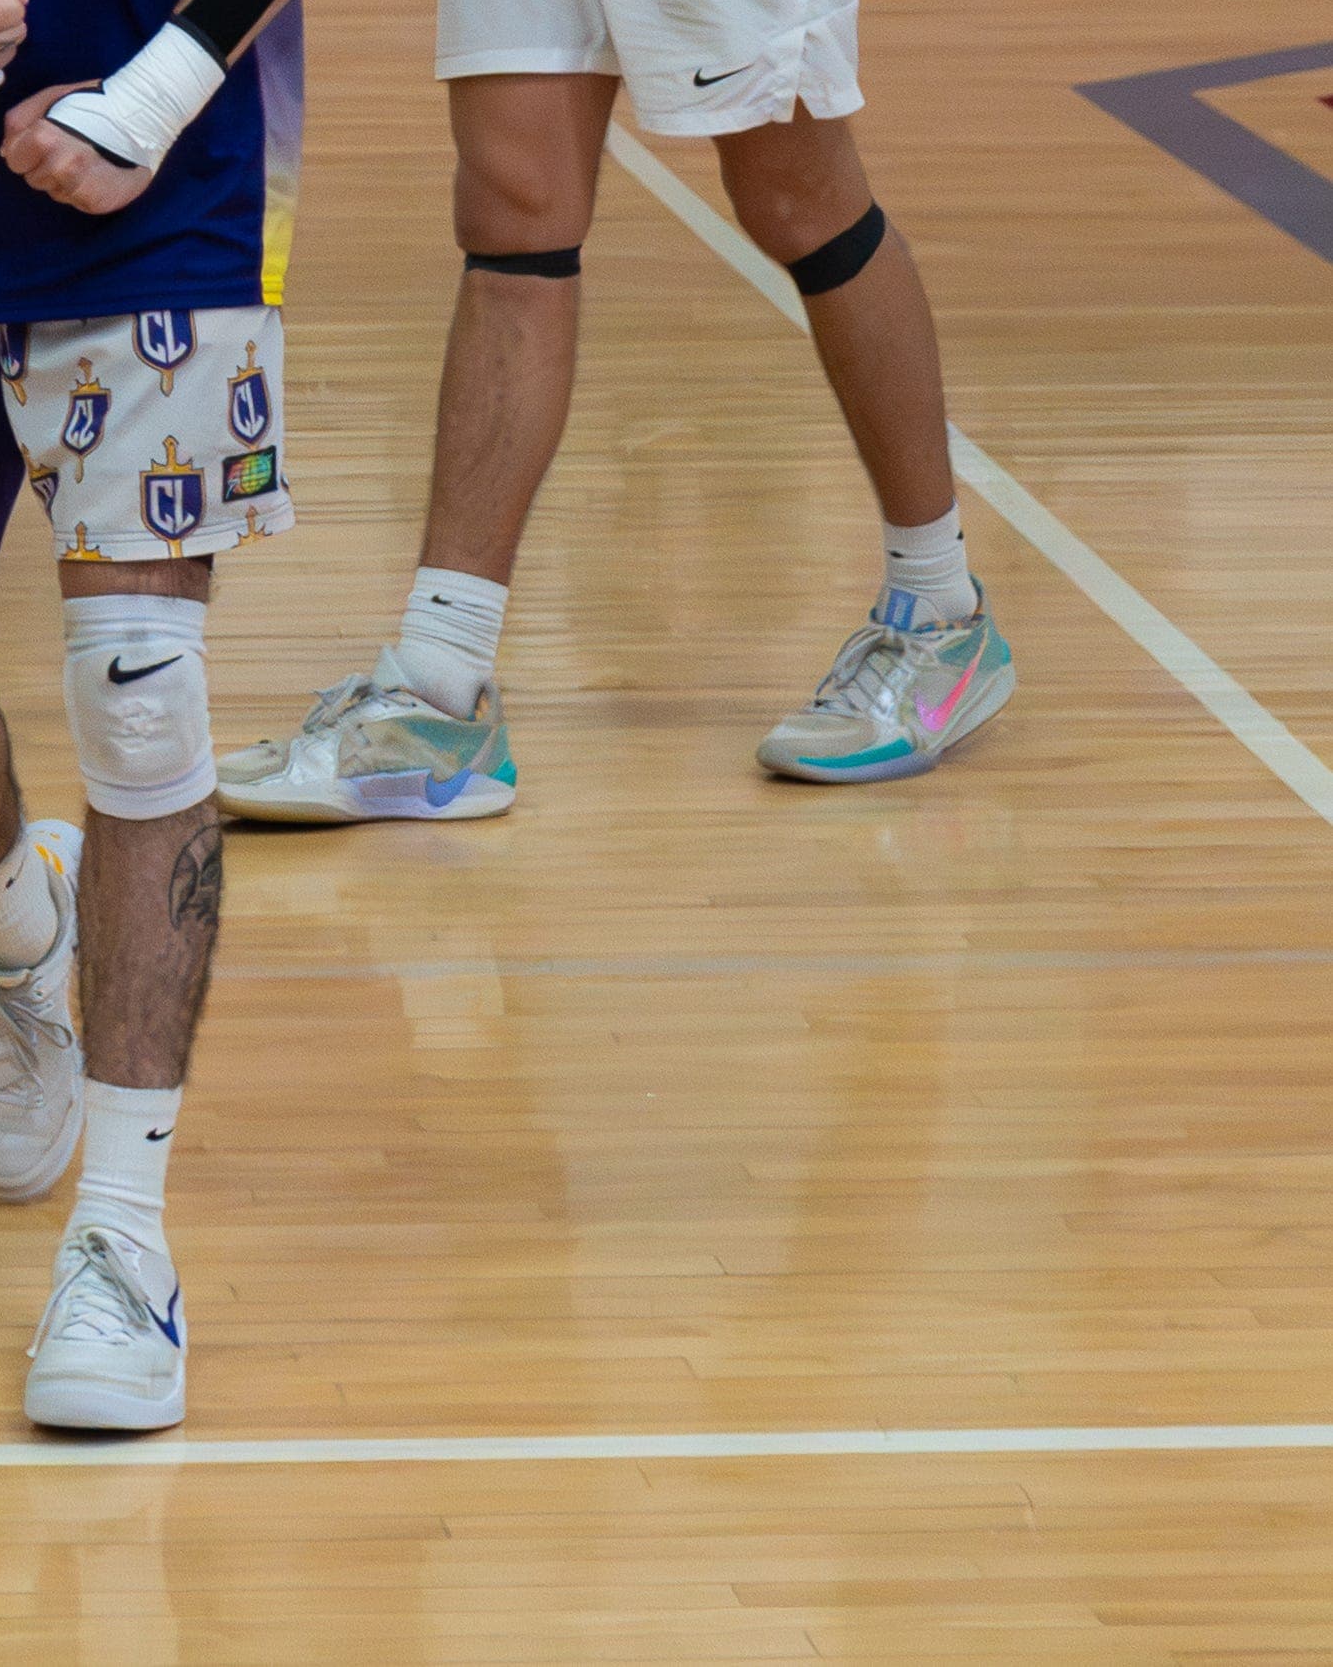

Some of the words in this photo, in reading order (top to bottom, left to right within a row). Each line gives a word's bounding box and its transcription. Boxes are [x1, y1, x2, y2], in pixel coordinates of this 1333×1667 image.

[137, 312, 187, 365] CL
[231, 381, 265, 439] CL
[150, 479, 196, 534] CL
